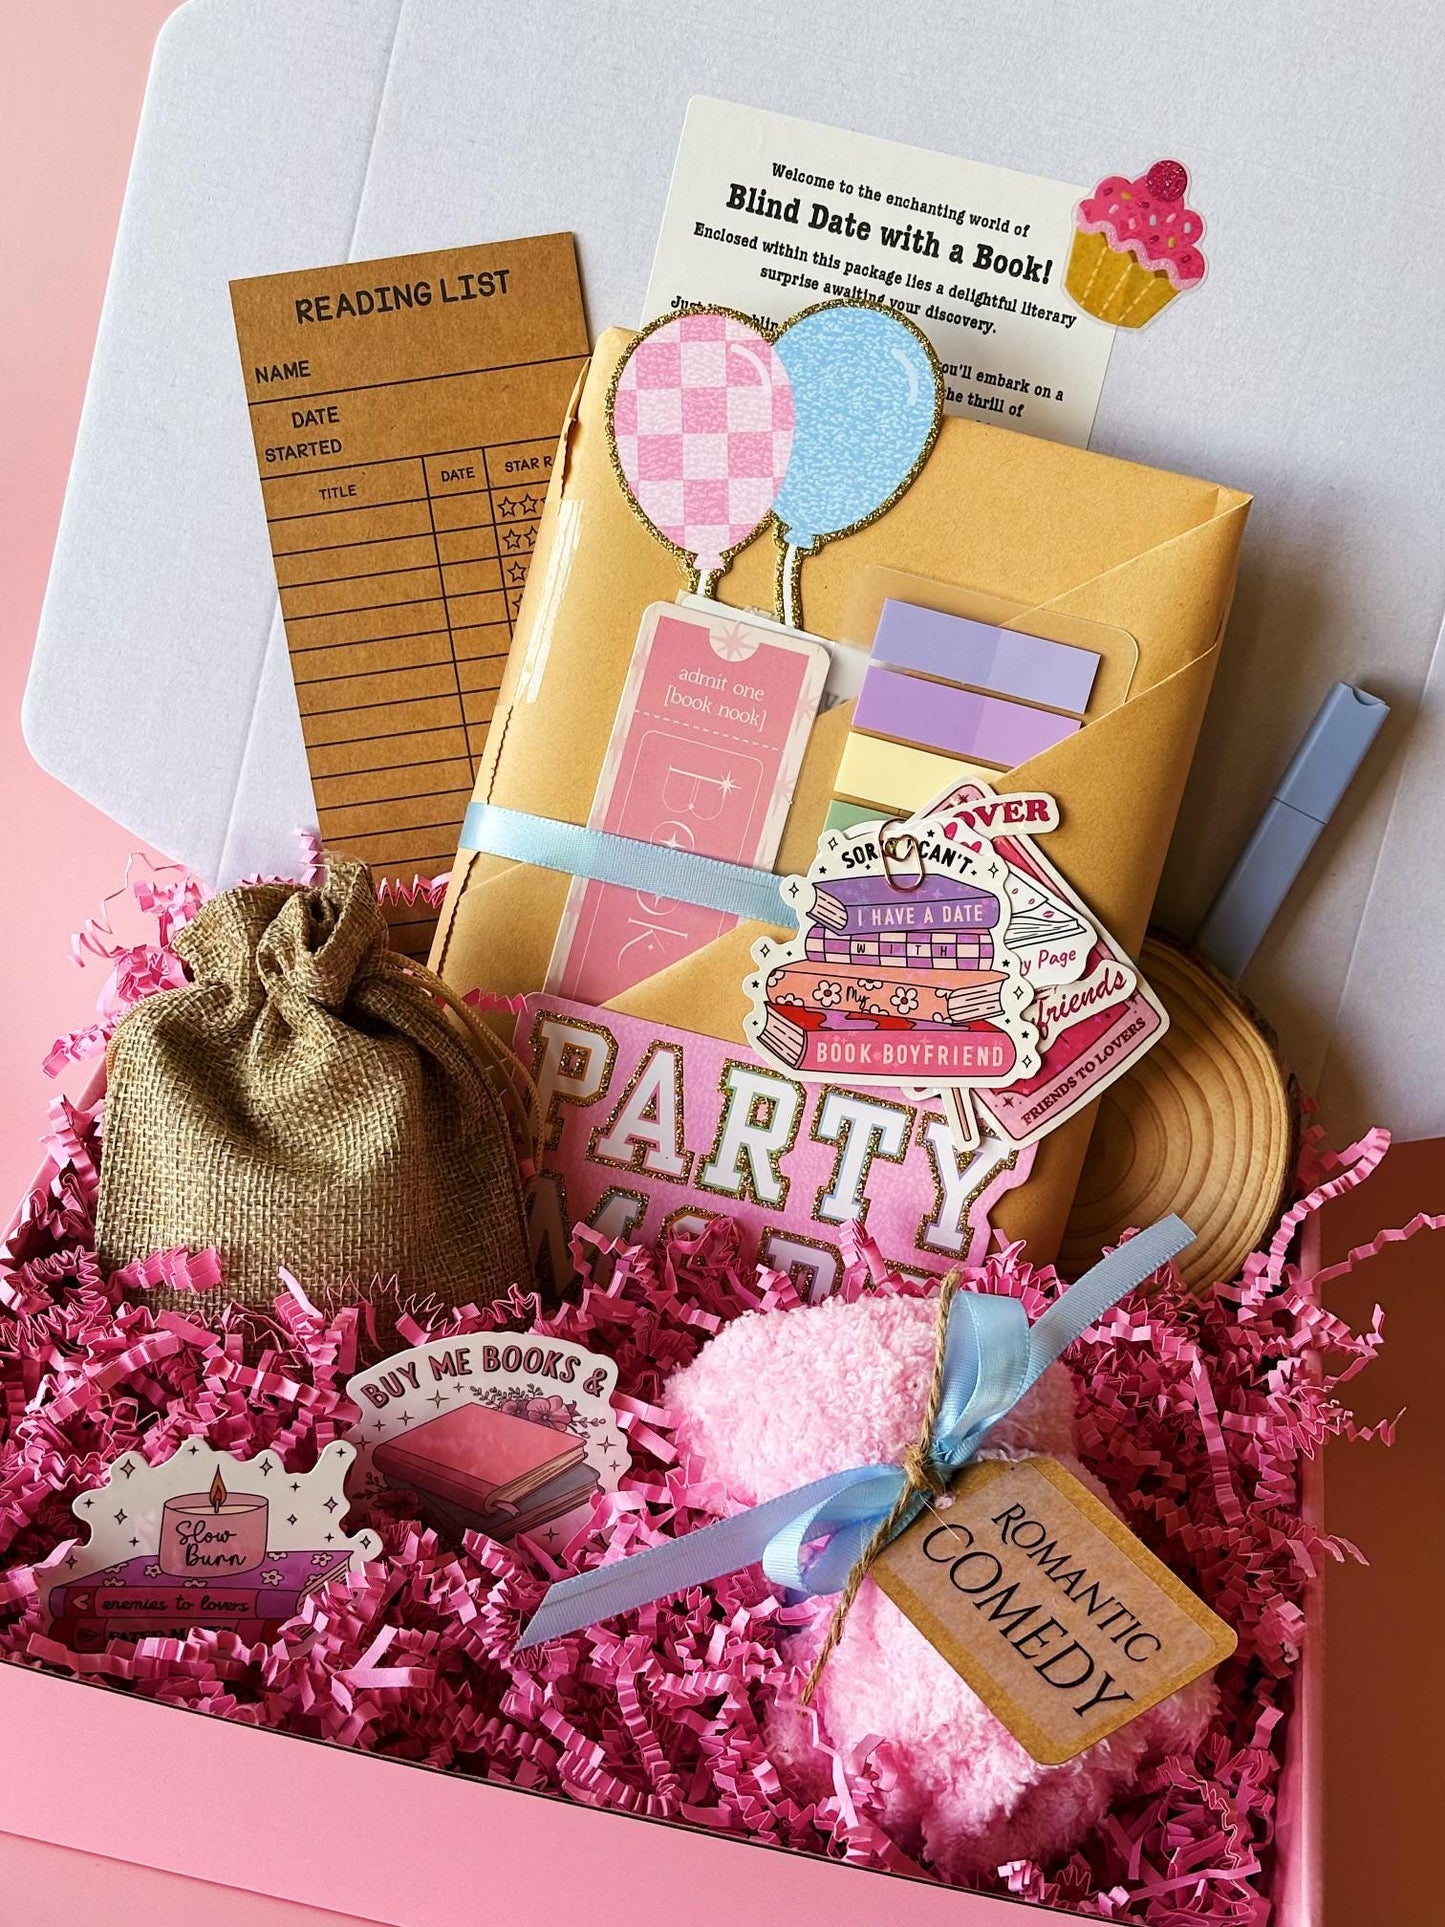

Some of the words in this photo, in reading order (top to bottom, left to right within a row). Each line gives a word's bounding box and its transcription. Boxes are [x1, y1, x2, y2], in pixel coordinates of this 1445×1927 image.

[772, 162, 835, 190] Welcome
[839, 180, 853, 195] to
[858, 184, 881, 201] the
[886, 193, 966, 225] enchanting
[969, 213, 1010, 233] world
[1014, 224, 1031, 238] of
[726, 183, 800, 224] Blind
[808, 203, 871, 241] Date
[880, 224, 940, 258] with
[949, 243, 964, 264] a
[973, 243, 1053, 285] Book!
[693, 222, 758, 250] Enclosed
[762, 241, 808, 262] within
[812, 251, 841, 269] this
[843, 262, 902, 286] package
[905, 273, 932, 292] lies
[936, 282, 944, 295] a
[948, 285, 1017, 311] delightful
[1021, 301, 1077, 329] literary
[296, 281, 432, 324] READING
[440, 269, 511, 303] LIST
[760, 267, 819, 290] surprise
[823, 282, 885, 303] awaiting
[890, 298, 921, 315] your
[925, 304, 996, 335] discovery.
[255, 360, 311, 384] NAME
[940, 362, 972, 380] ou'll
[976, 371, 1030, 394] embark
[1034, 385, 1051, 399] on
[1055, 390, 1064, 401] a
[291, 406, 340, 429] DATE
[943, 387, 963, 403] he
[968, 392, 1004, 413] thrill
[1008, 404, 1025, 418] of
[265, 438, 343, 463] STARTED
[505, 457, 539, 473] STAR
[440, 466, 476, 482] DATE
[319, 484, 357, 501] TITLE
[678, 666, 728, 691] admit
[733, 684, 765, 702] one
[664, 684, 712, 714] [book
[719, 704, 768, 732] nook]
[920, 840, 973, 875] CAN'T
[858, 910, 863, 926] I
[872, 907, 915, 926] HAVE
[924, 906, 933, 923] A
[943, 904, 983, 922] DATE
[1038, 949, 1077, 969] Page
[816, 1041, 872, 1064] BOOK
[882, 1043, 1003, 1068] BOYFRIEND
[1021, 1076, 1078, 1126] FRIENDS
[1075, 1061, 1096, 1080] TO
[1094, 1017, 1146, 1063] LOVERS
[533, 1008, 1018, 1260] PARTY
[360, 1361, 421, 1409] BUY
[428, 1348, 473, 1381] ME
[482, 1345, 582, 1383] BOOKS
[583, 1367, 608, 1397] &
[176, 1520, 237, 1544] Slow
[185, 1543, 246, 1567] Burn
[991, 1502, 1162, 1663] ROMANTIC
[102, 1599, 168, 1612] enemies
[176, 1594, 194, 1611] to
[200, 1595, 250, 1613] lovers
[921, 1523, 1135, 1718] COMEDY
